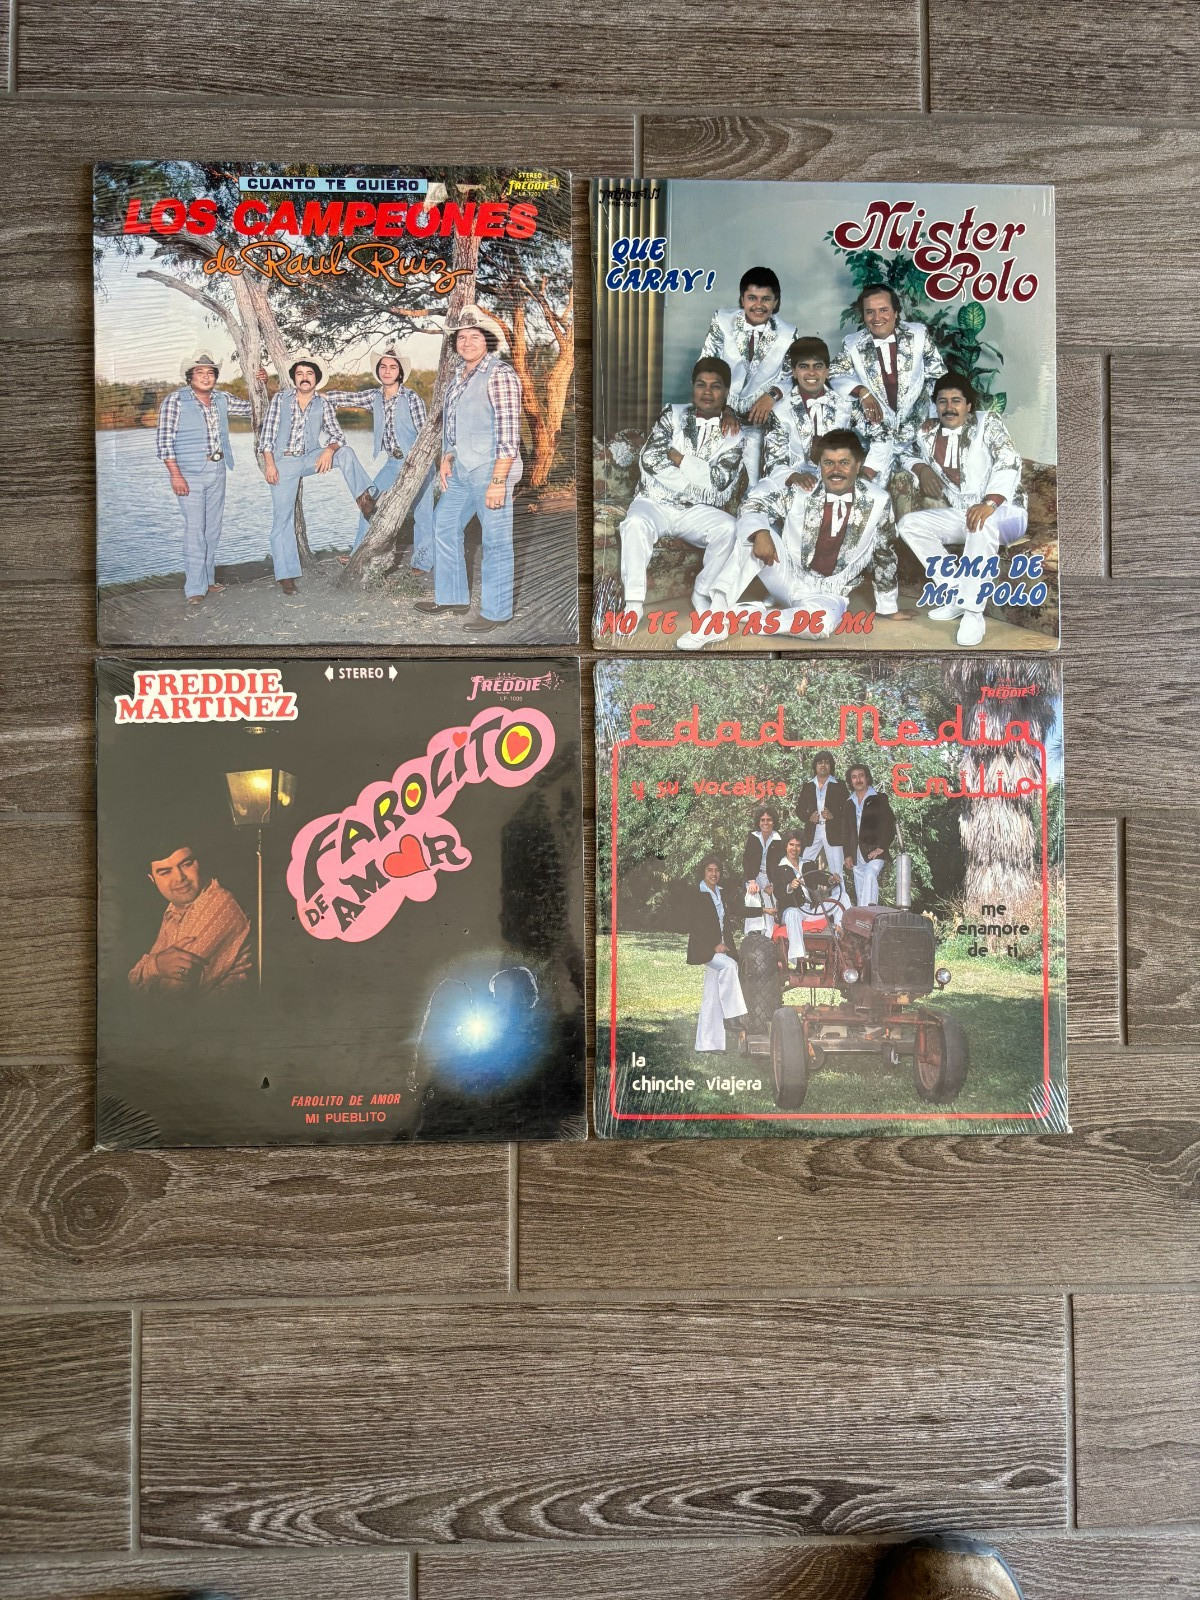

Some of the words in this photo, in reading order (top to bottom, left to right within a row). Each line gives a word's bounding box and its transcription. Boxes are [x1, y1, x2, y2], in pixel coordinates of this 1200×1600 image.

[247, 178, 316, 190] CUANTO
[325, 179, 346, 190] TE
[356, 179, 419, 191] QUIERO
[123, 198, 217, 235] LOS
[233, 199, 539, 239] CAMPEONES
[833, 200, 1027, 274] Mister
[611, 237, 668, 266] QUE
[202, 244, 244, 276] de
[240, 240, 347, 287] Raul
[347, 243, 474, 294] Ruiz
[924, 251, 1040, 303] Polo
[925, 554, 1000, 579] TEMA
[1008, 554, 1044, 579] DE
[916, 582, 965, 607] Mr.
[975, 582, 1048, 606] POLO
[601, 610, 638, 636] NO
[647, 610, 680, 635] TE
[689, 610, 781, 636] VAYAS
[790, 610, 827, 635] DE
[834, 611, 876, 636] MI
[137, 672, 280, 696] FREDDIE
[339, 668, 384, 679] STEREO
[466, 675, 541, 701] FREDDIE
[978, 686, 1028, 704] FREDDIE
[118, 696, 295, 720] MARTINEZ
[629, 703, 784, 747] Edad
[836, 703, 1034, 747] Media
[631, 780, 645, 801] y
[656, 781, 679, 799] su
[692, 775, 787, 799] vocalista
[891, 762, 1033, 798] Emilio
[981, 904, 1007, 918] me
[957, 923, 1030, 938] enamore
[967, 942, 989, 958] de
[1007, 942, 1018, 958] ti
[632, 1051, 646, 1068] la
[632, 1075, 696, 1094] chinche
[706, 1075, 762, 1096] viajera
[291, 1095, 344, 1107] FAROLITO
[348, 1094, 364, 1106] DE
[369, 1093, 401, 1105] AMOR
[305, 1113, 320, 1124] MI
[325, 1111, 387, 1123] PUEBLITO
